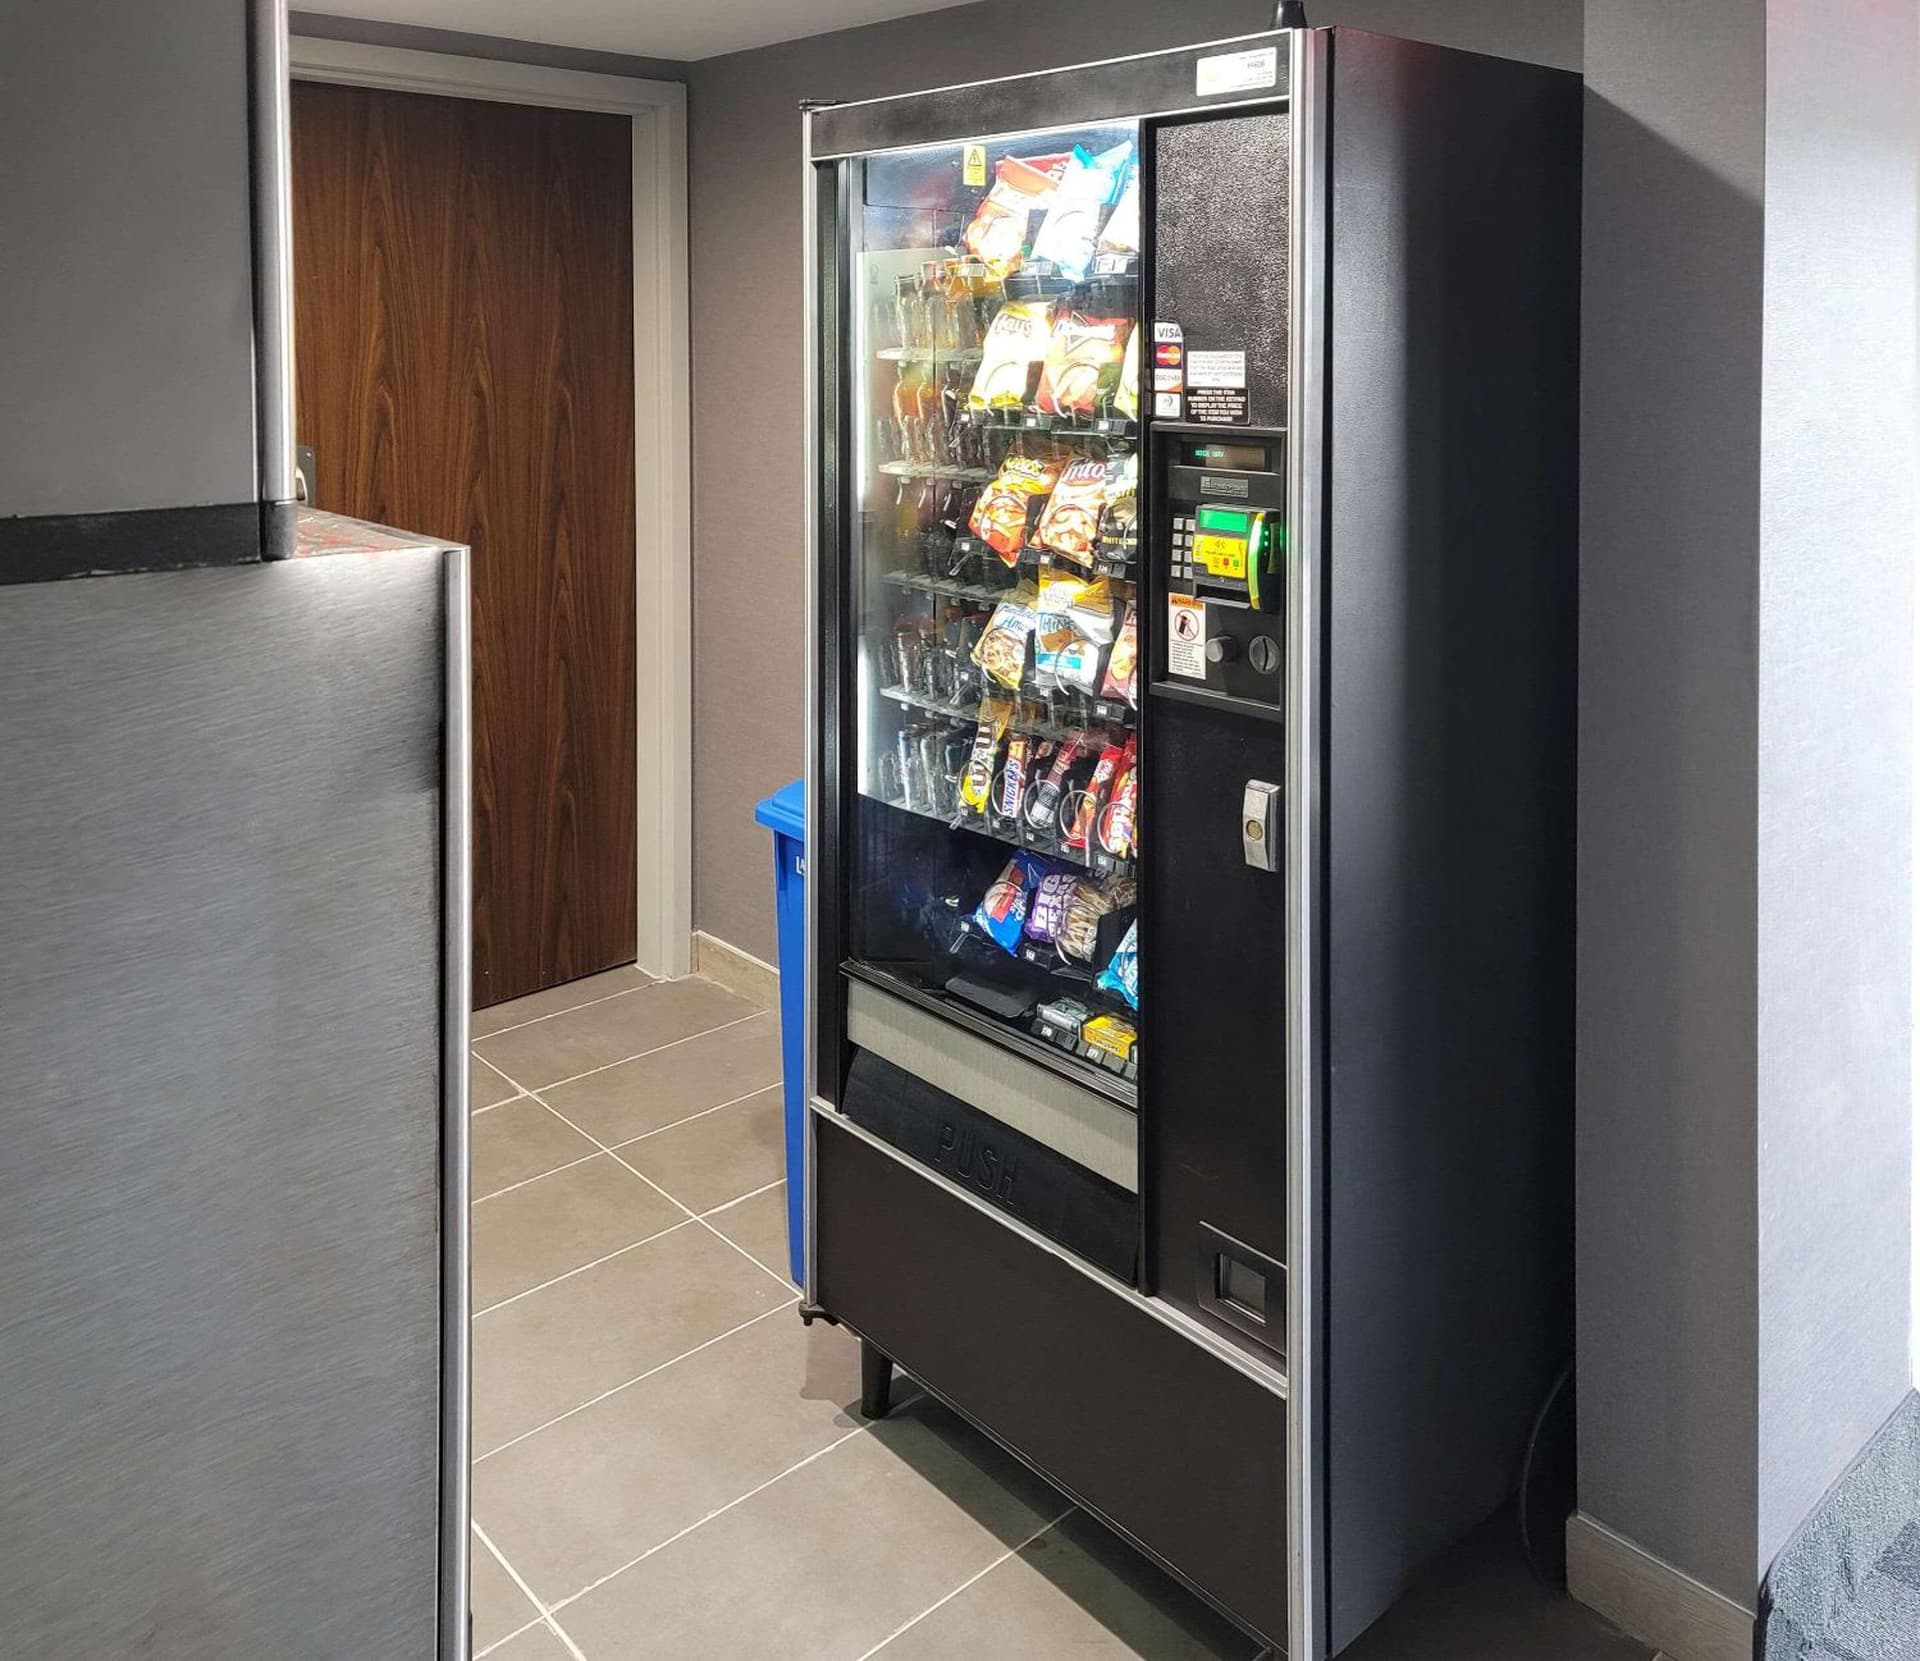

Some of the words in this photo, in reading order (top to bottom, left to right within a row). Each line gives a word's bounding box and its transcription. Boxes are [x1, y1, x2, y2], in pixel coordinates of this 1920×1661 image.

[1159, 327, 1181, 338] VISA
[1003, 757, 1021, 817] SNICKERS
[1034, 874, 1061, 930] BIG
[933, 1124, 1017, 1206] PUSH
